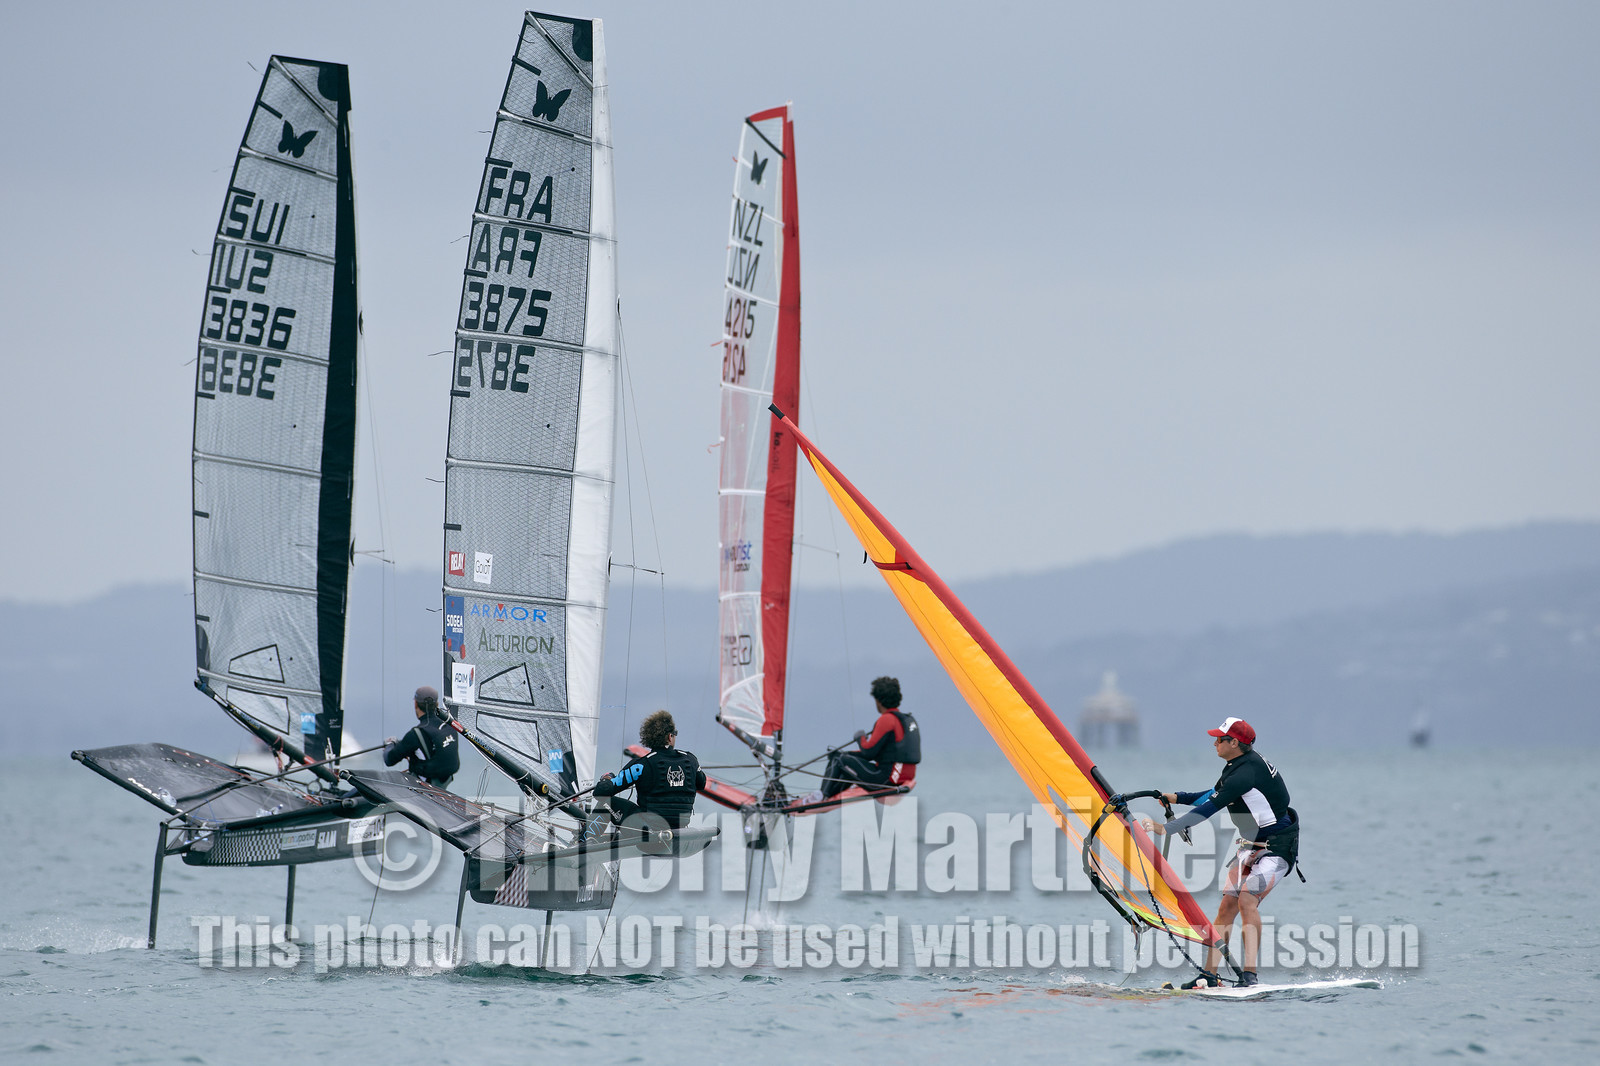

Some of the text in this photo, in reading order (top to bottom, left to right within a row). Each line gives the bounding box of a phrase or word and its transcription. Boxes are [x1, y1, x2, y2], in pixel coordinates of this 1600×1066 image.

[225, 195, 290, 244] SUI
[486, 167, 553, 223] FRA
[732, 198, 764, 247] NZL
[206, 297, 296, 350] 3836
[464, 281, 552, 337] 3875
[725, 297, 757, 339] 4215
[446, 614, 464, 627] SOGEA
[470, 603, 547, 623] ARMOR
[478, 627, 555, 654] ALTURION
